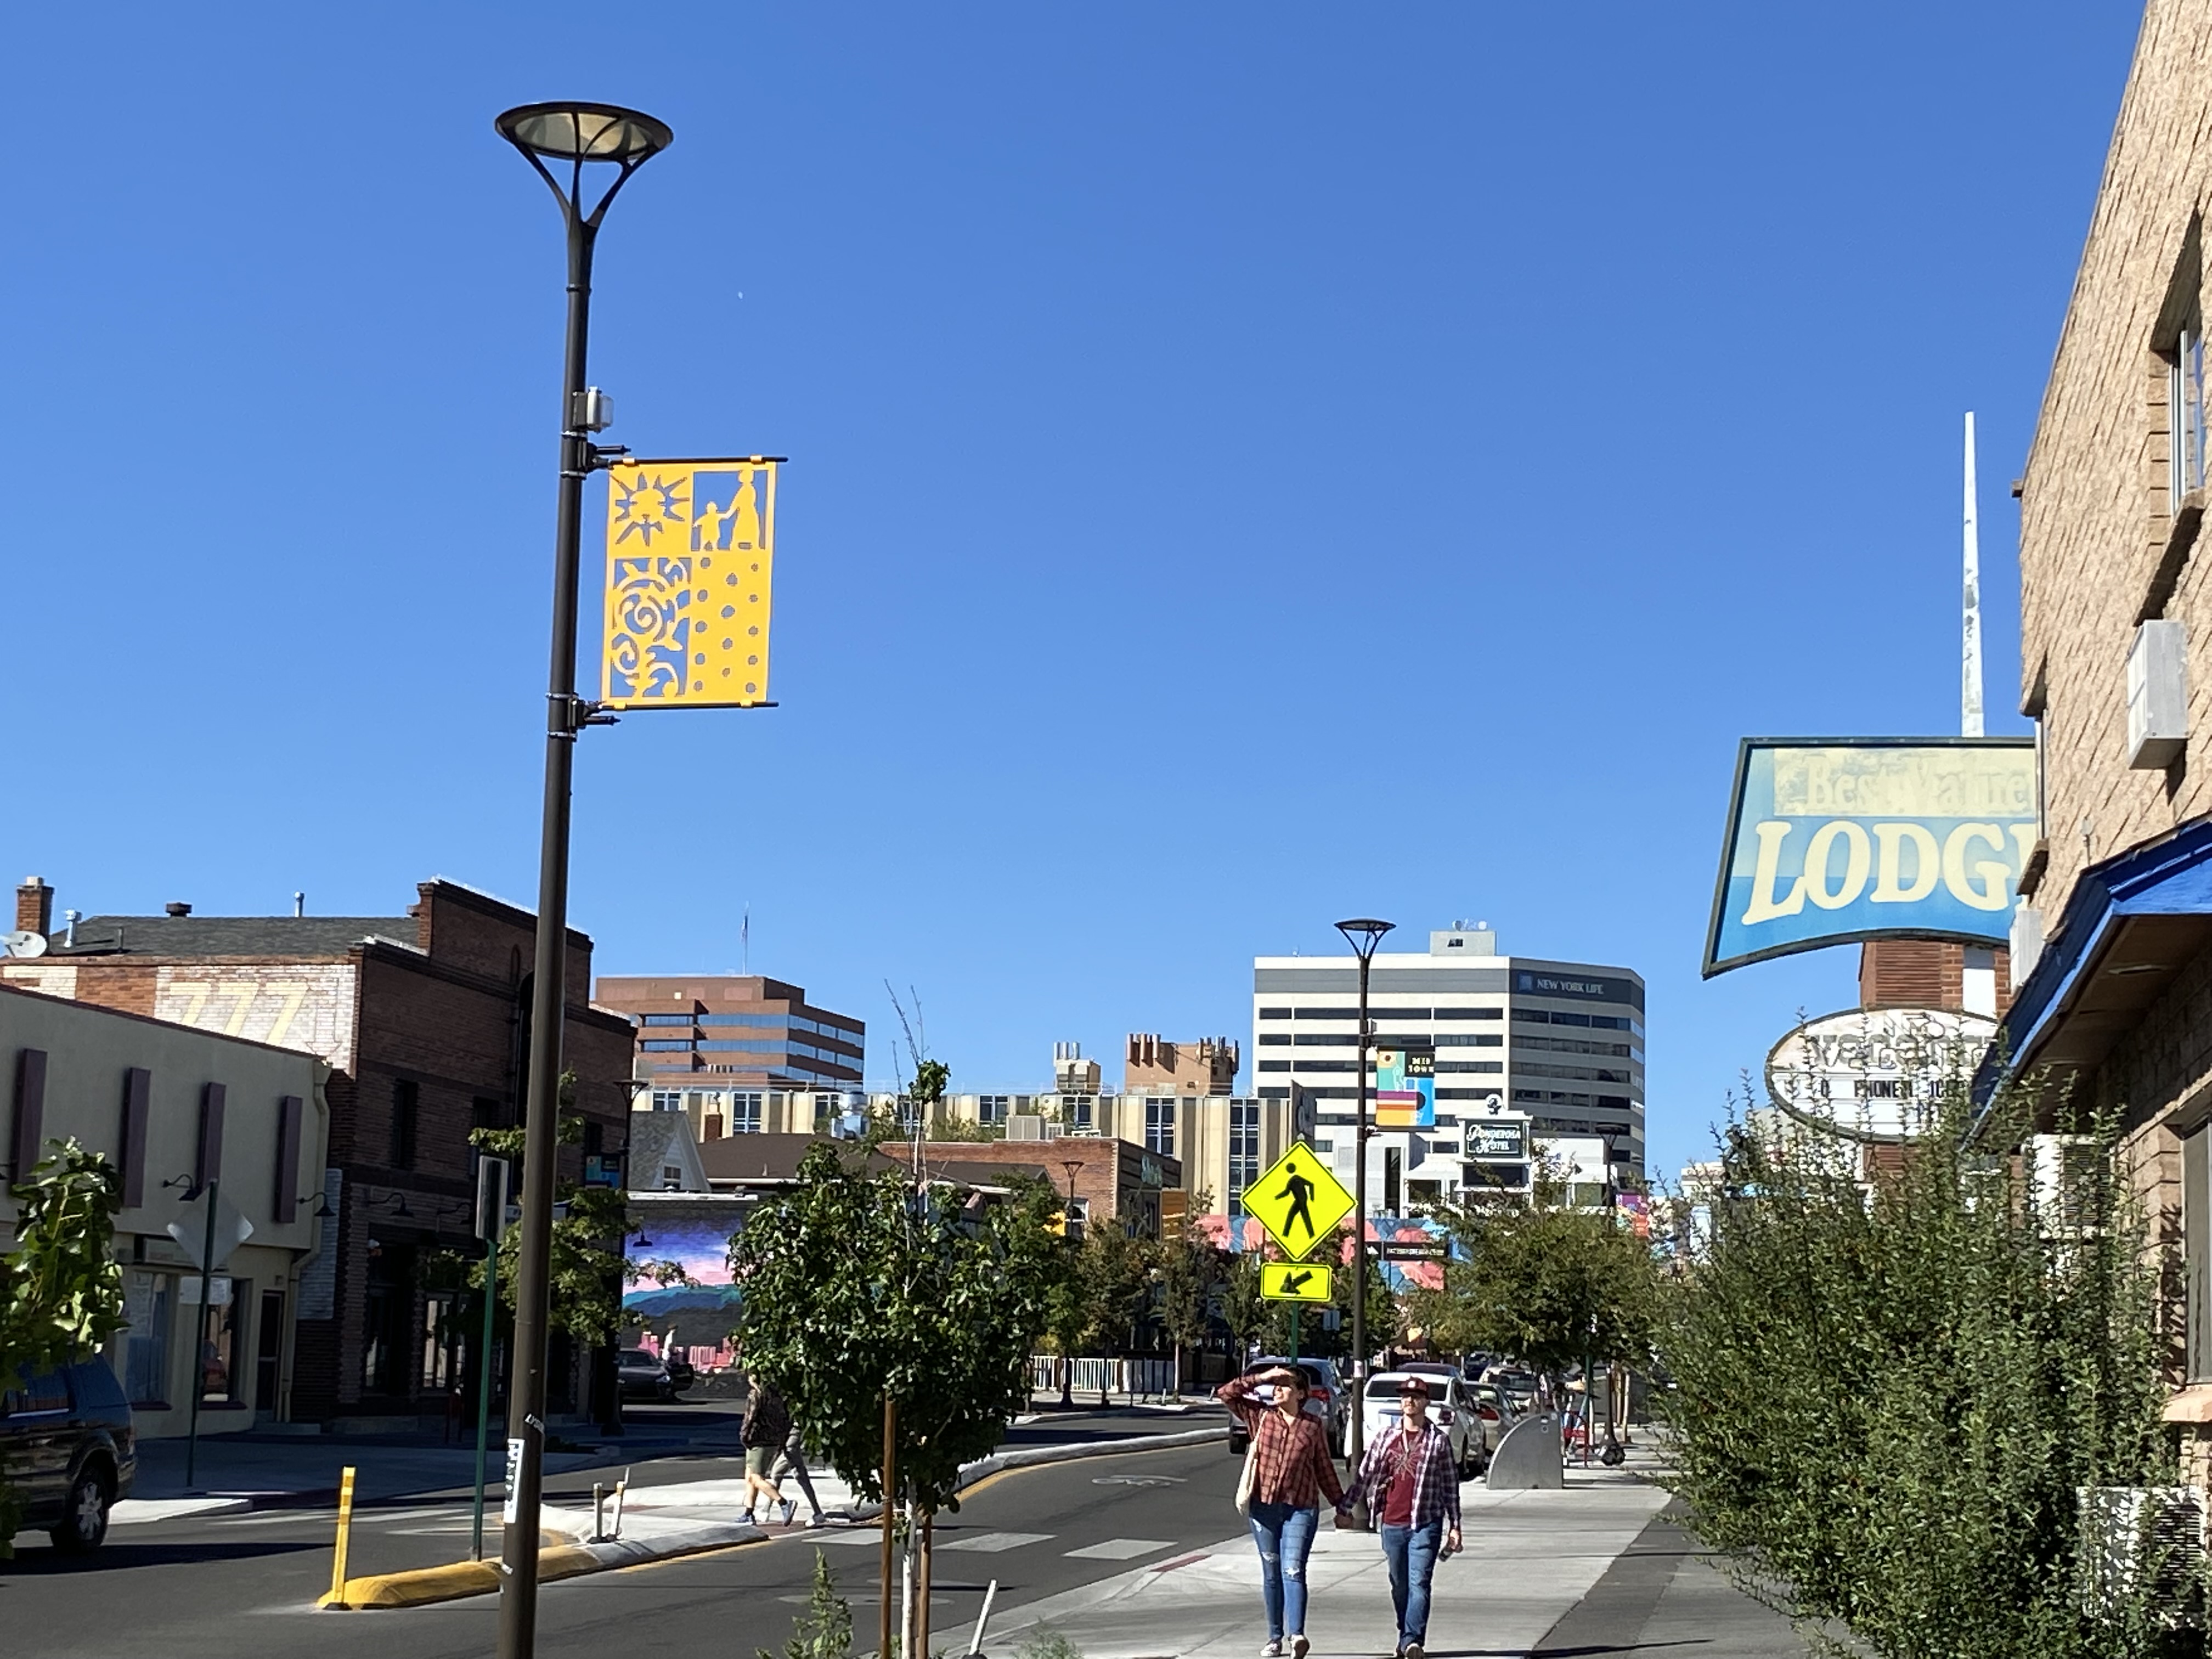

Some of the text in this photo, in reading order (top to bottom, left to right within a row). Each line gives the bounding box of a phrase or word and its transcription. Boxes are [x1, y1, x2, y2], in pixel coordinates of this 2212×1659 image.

[1537, 978, 1604, 995] NEW YORK LIFE
[1854, 1080, 1900, 1098] PHONE
